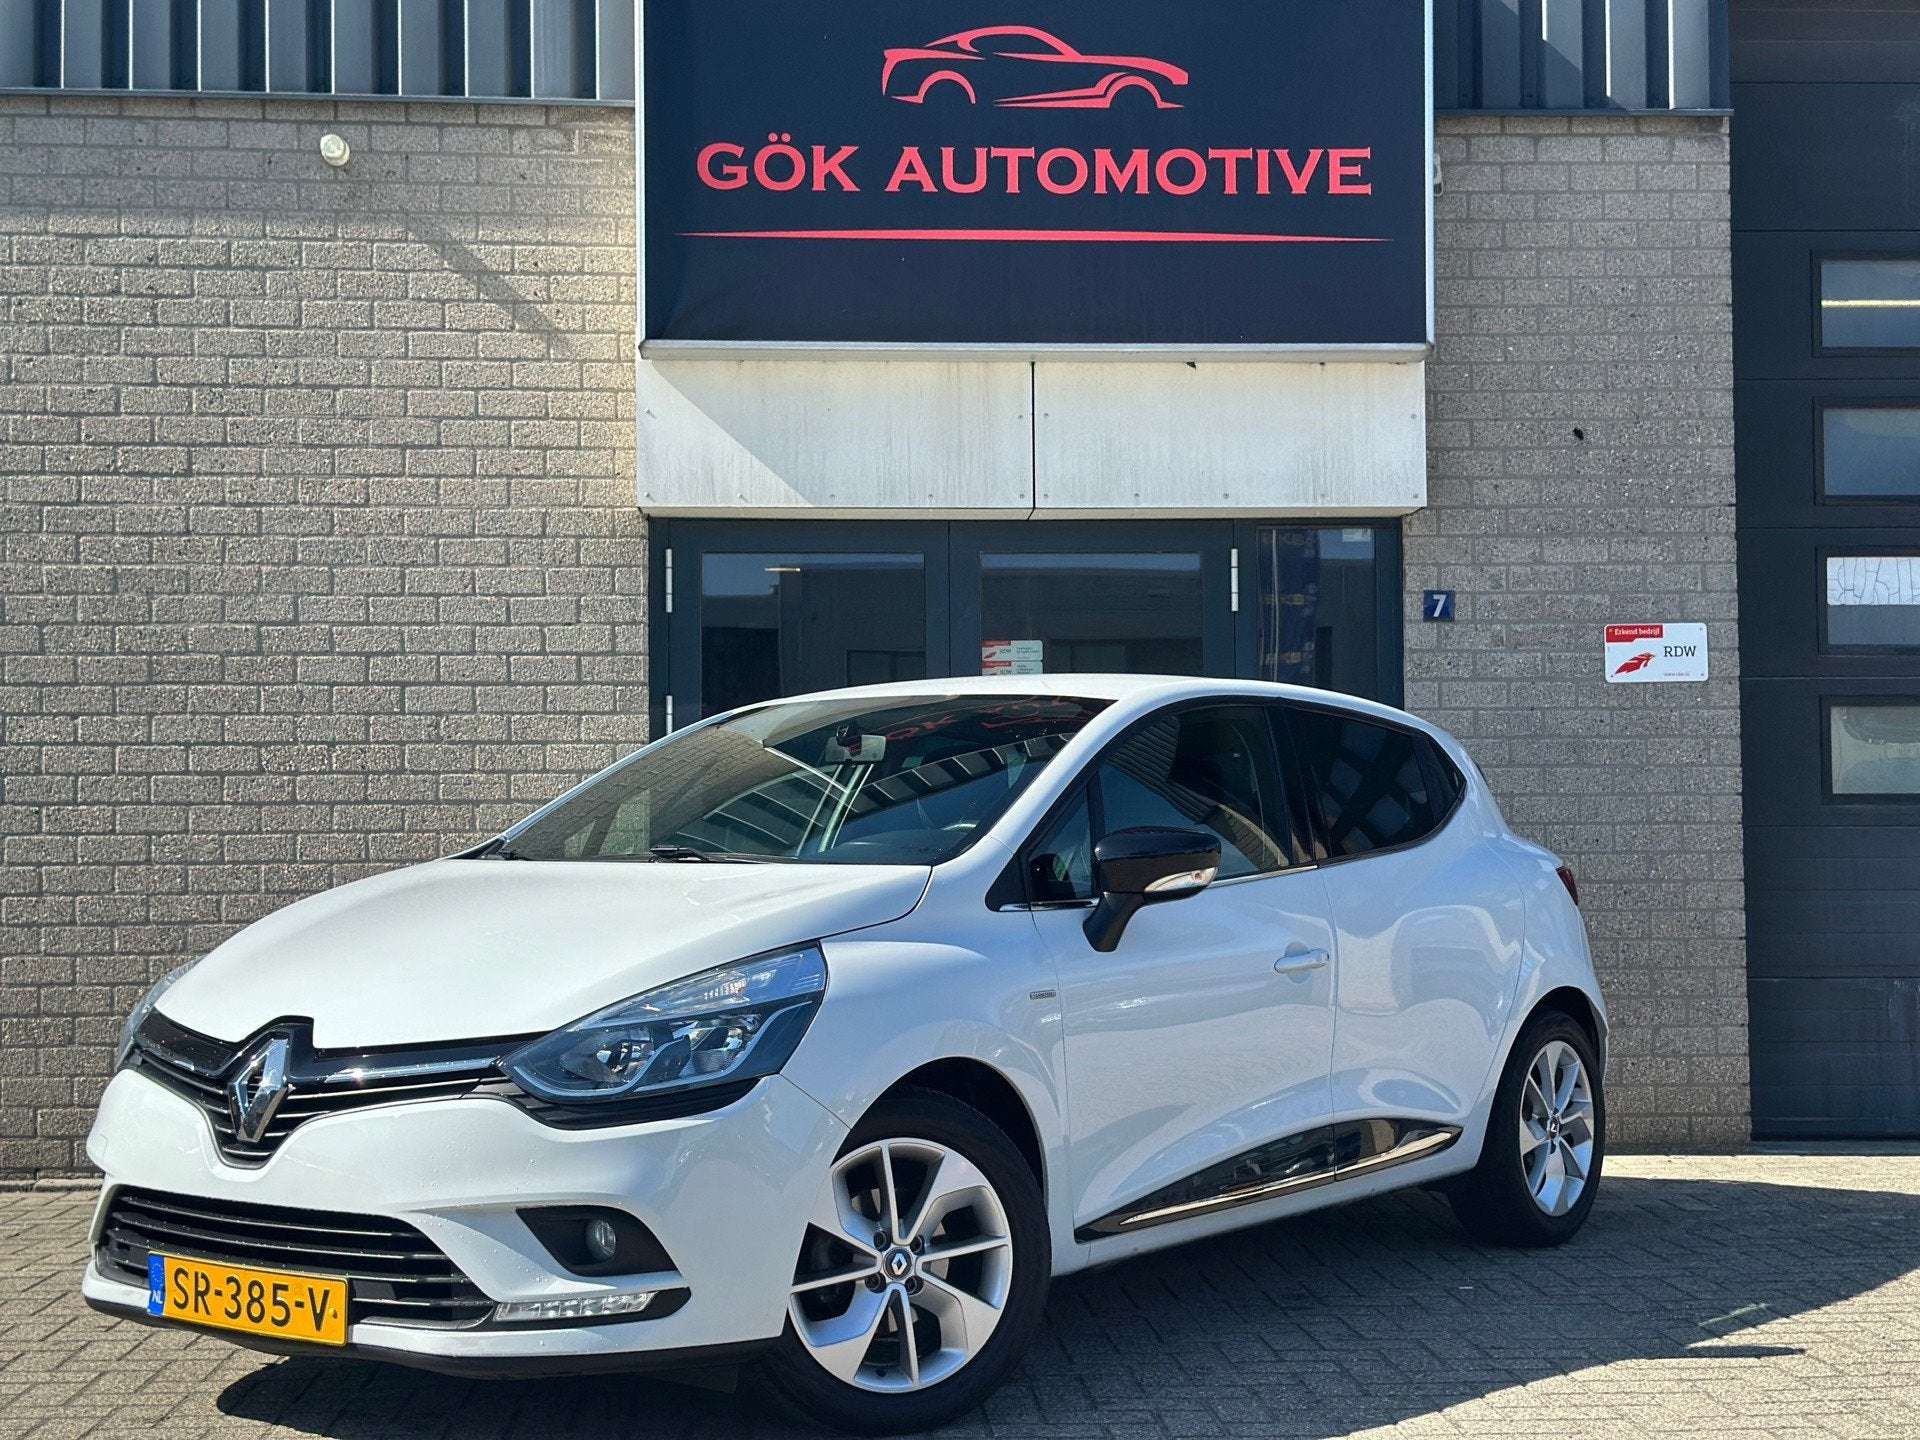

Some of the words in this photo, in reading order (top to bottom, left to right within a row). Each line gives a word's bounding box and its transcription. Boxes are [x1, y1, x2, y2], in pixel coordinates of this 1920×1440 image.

[696, 132, 860, 193] GÖK
[885, 146, 1372, 197] AUTOMOTIVE
[1432, 594, 1448, 618] 7
[1639, 628, 1660, 636] bedrijf
[1663, 645, 1697, 658] RDW
[152, 1290, 163, 1304] NL
[173, 1267, 331, 1332] SR-385-V
